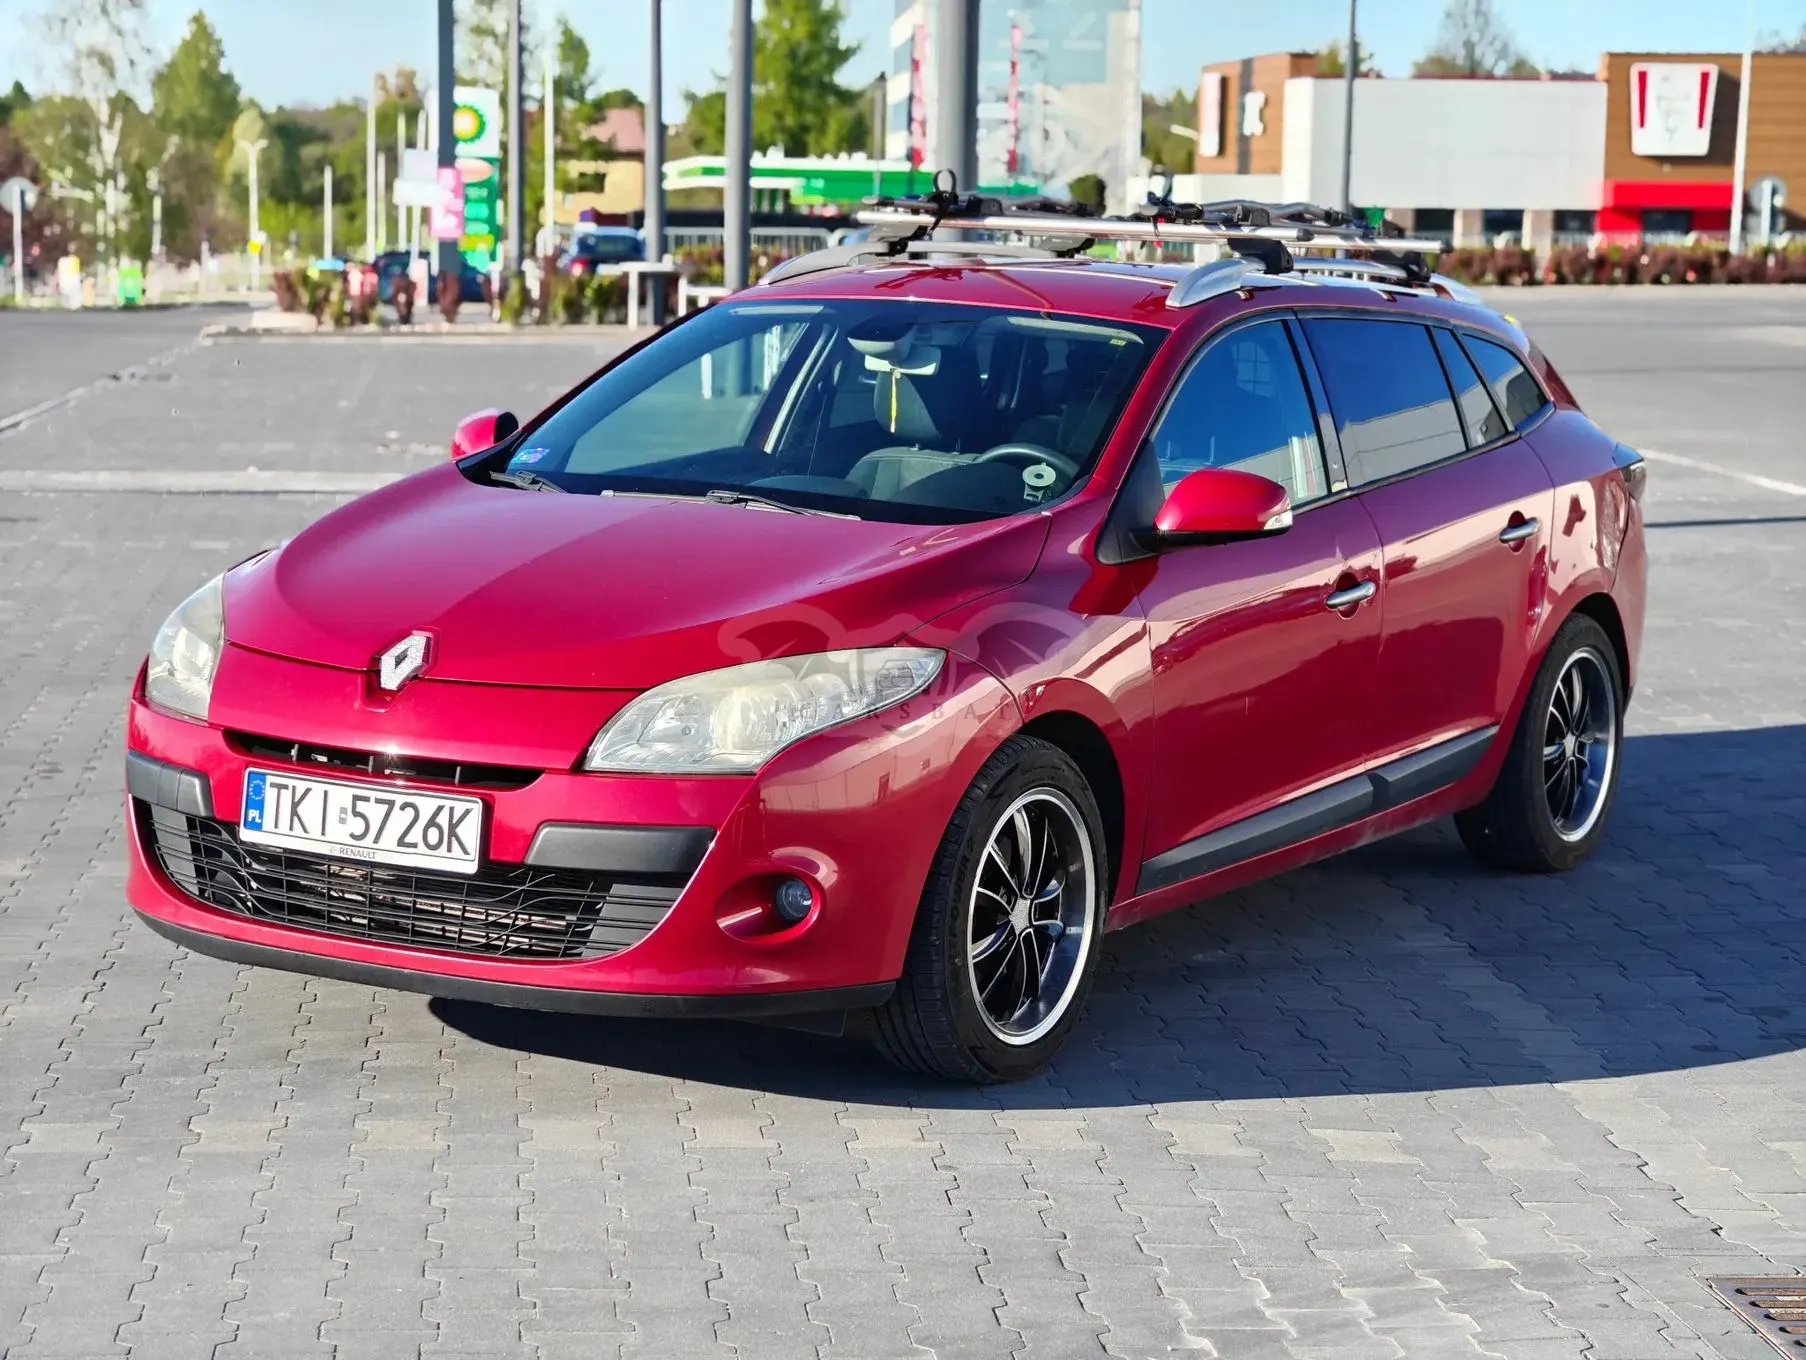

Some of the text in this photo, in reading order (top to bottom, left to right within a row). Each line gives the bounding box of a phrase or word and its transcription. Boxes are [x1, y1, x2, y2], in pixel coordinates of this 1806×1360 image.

[248, 808, 262, 823] PL
[269, 782, 474, 856] TKI 5726K
[339, 847, 376, 859] RENAULT
